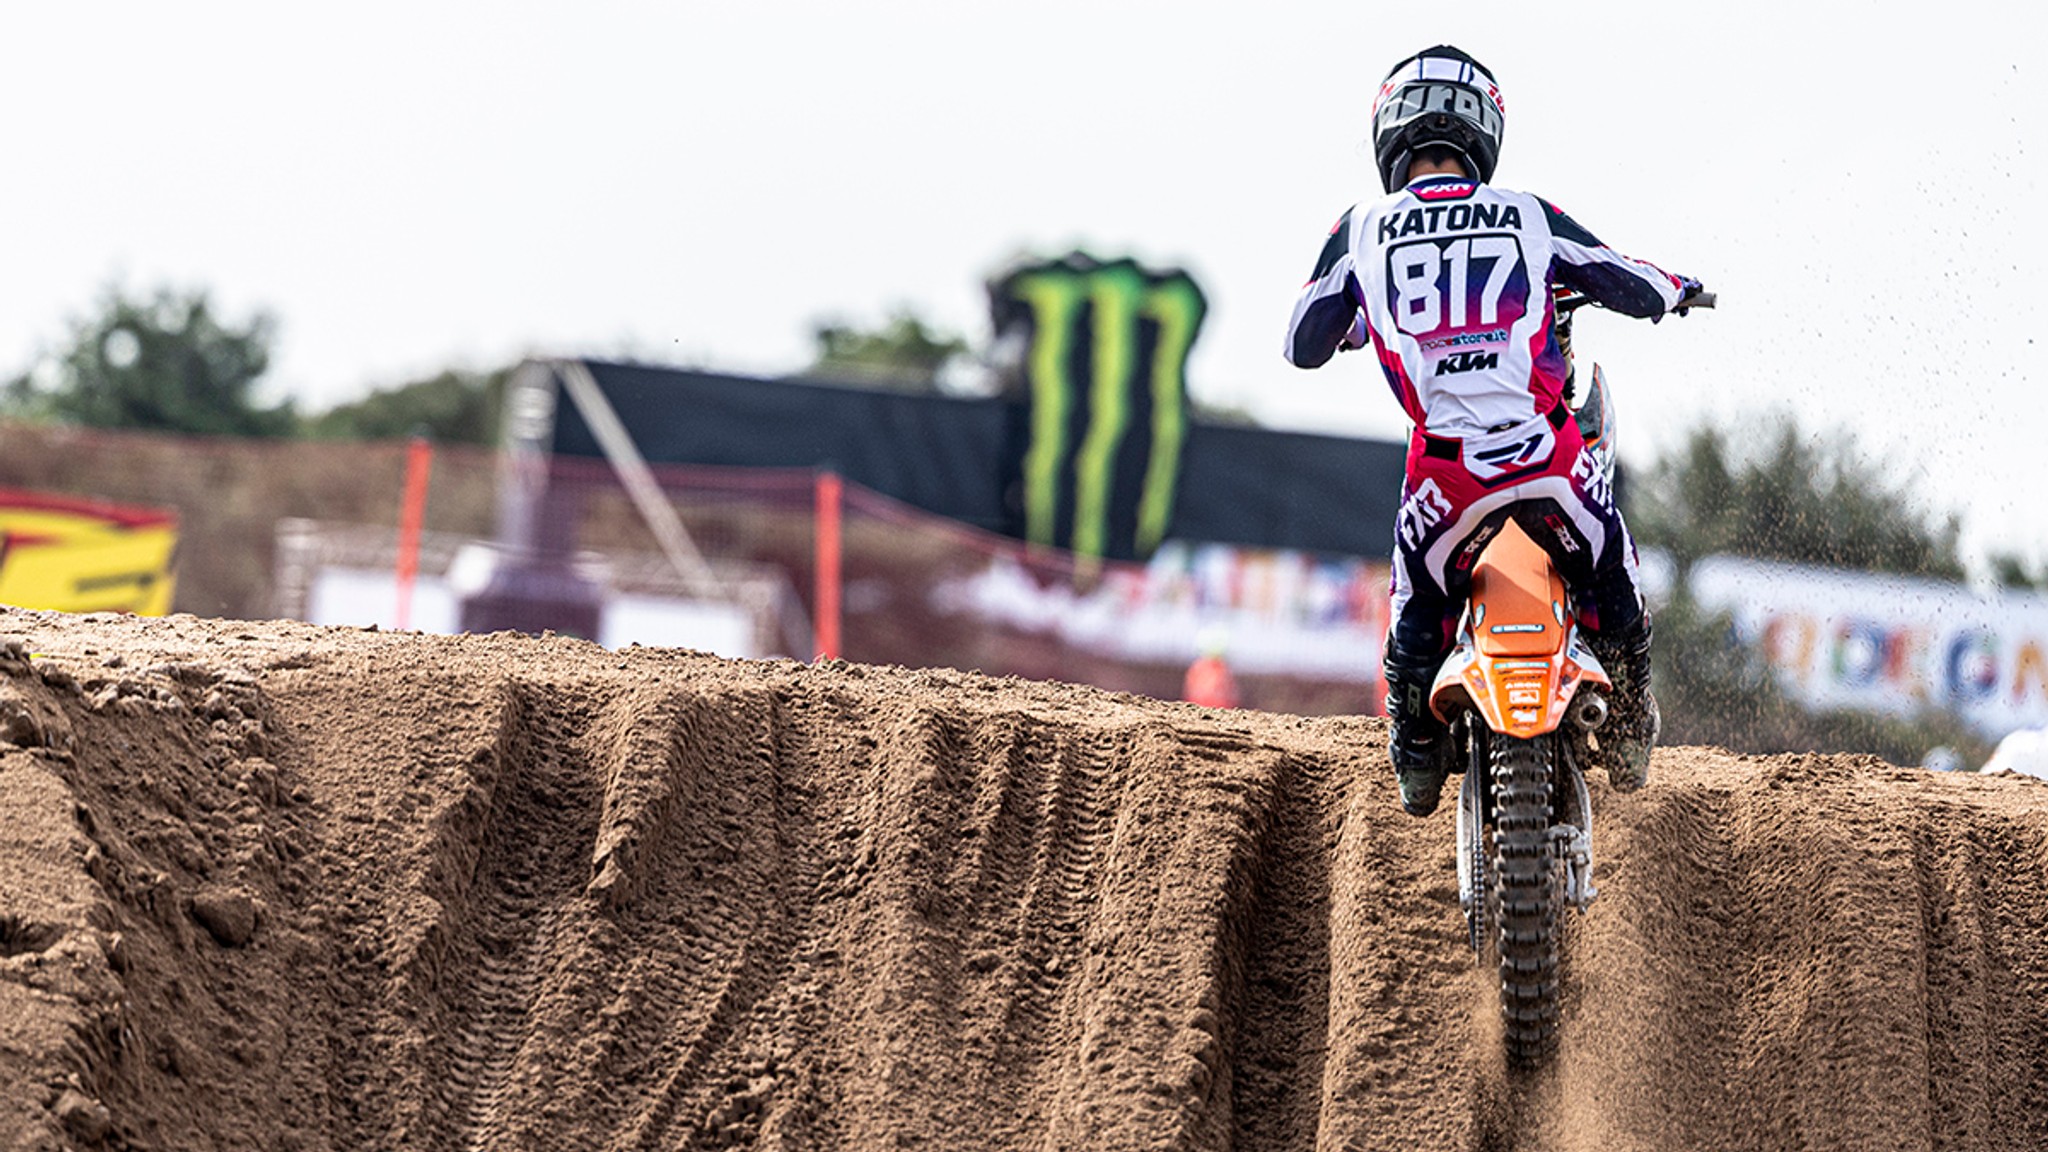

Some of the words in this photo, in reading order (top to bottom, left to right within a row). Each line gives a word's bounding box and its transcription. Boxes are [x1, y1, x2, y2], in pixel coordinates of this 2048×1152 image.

[1378, 203, 1522, 245] KATONA
[1390, 237, 1520, 336] 817
[1435, 349, 1498, 376] KTM
[1399, 477, 1453, 552] FXR
